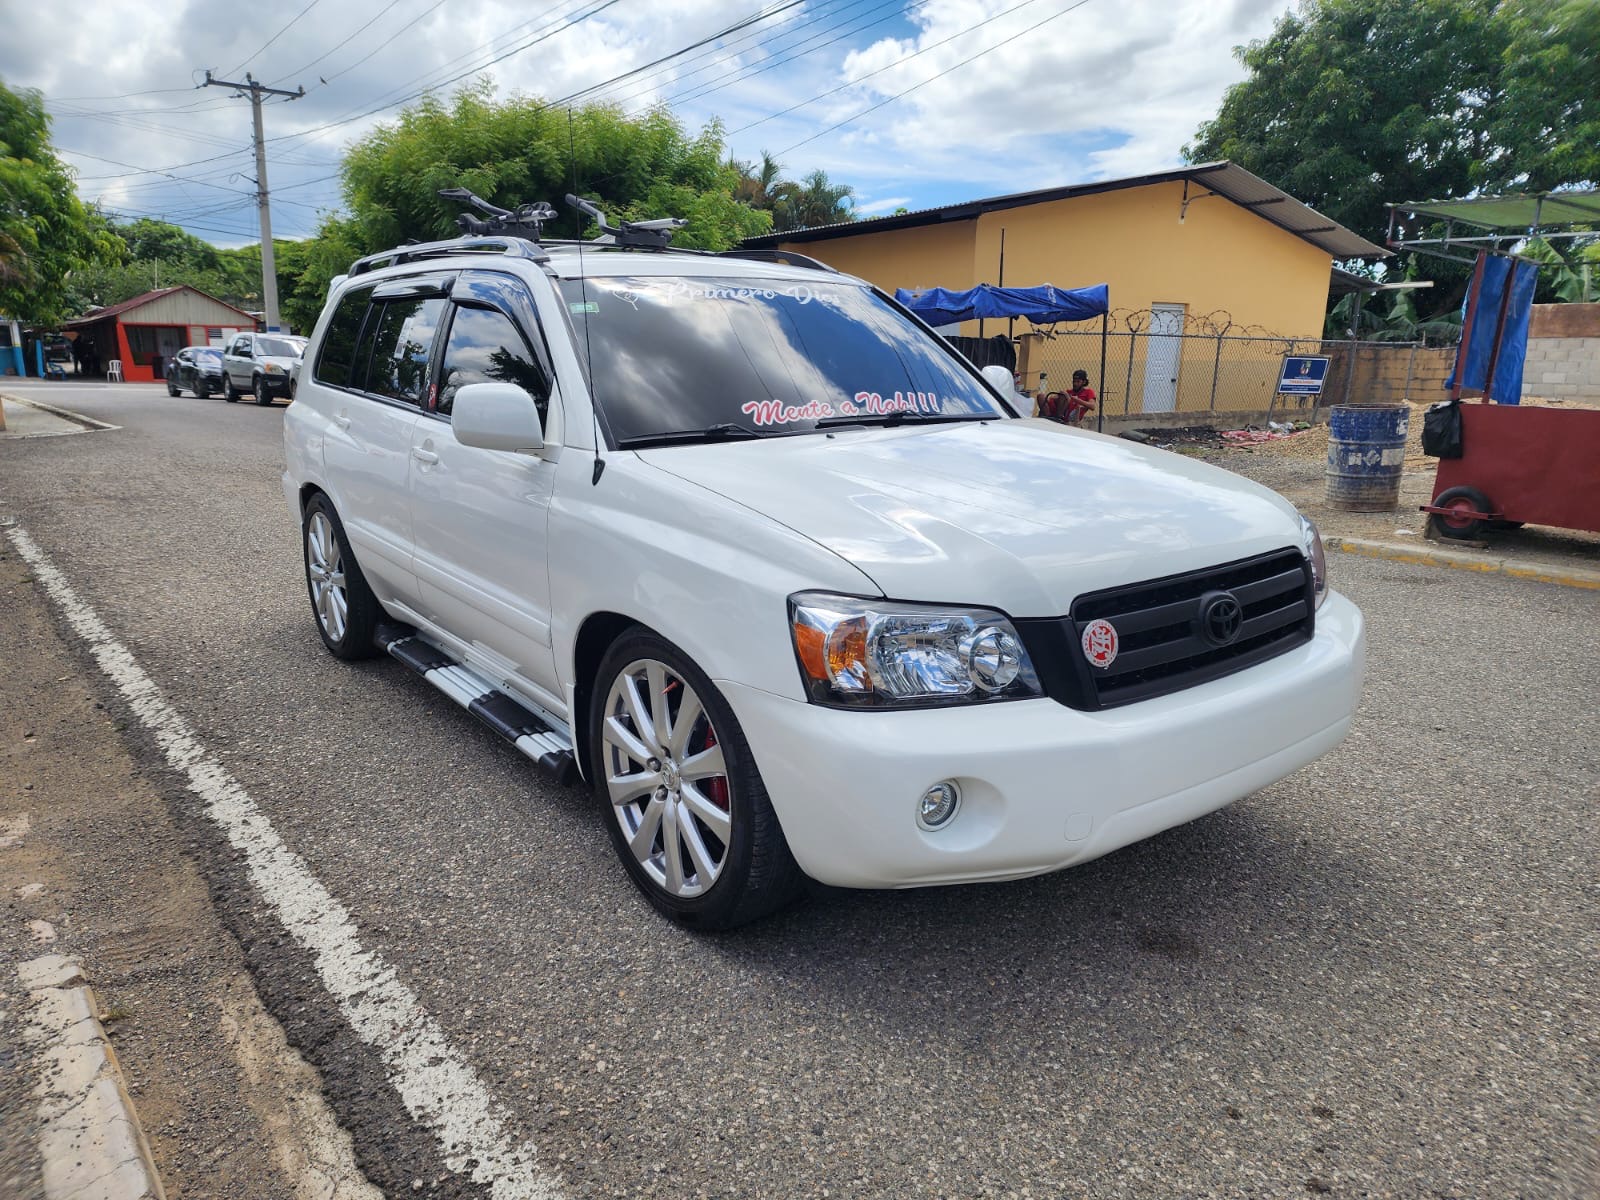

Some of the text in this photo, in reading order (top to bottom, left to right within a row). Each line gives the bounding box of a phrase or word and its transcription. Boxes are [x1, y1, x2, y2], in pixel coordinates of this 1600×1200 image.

[665, 280, 781, 305] Primero
[742, 400, 834, 426] Mente
[839, 400, 859, 416] a
